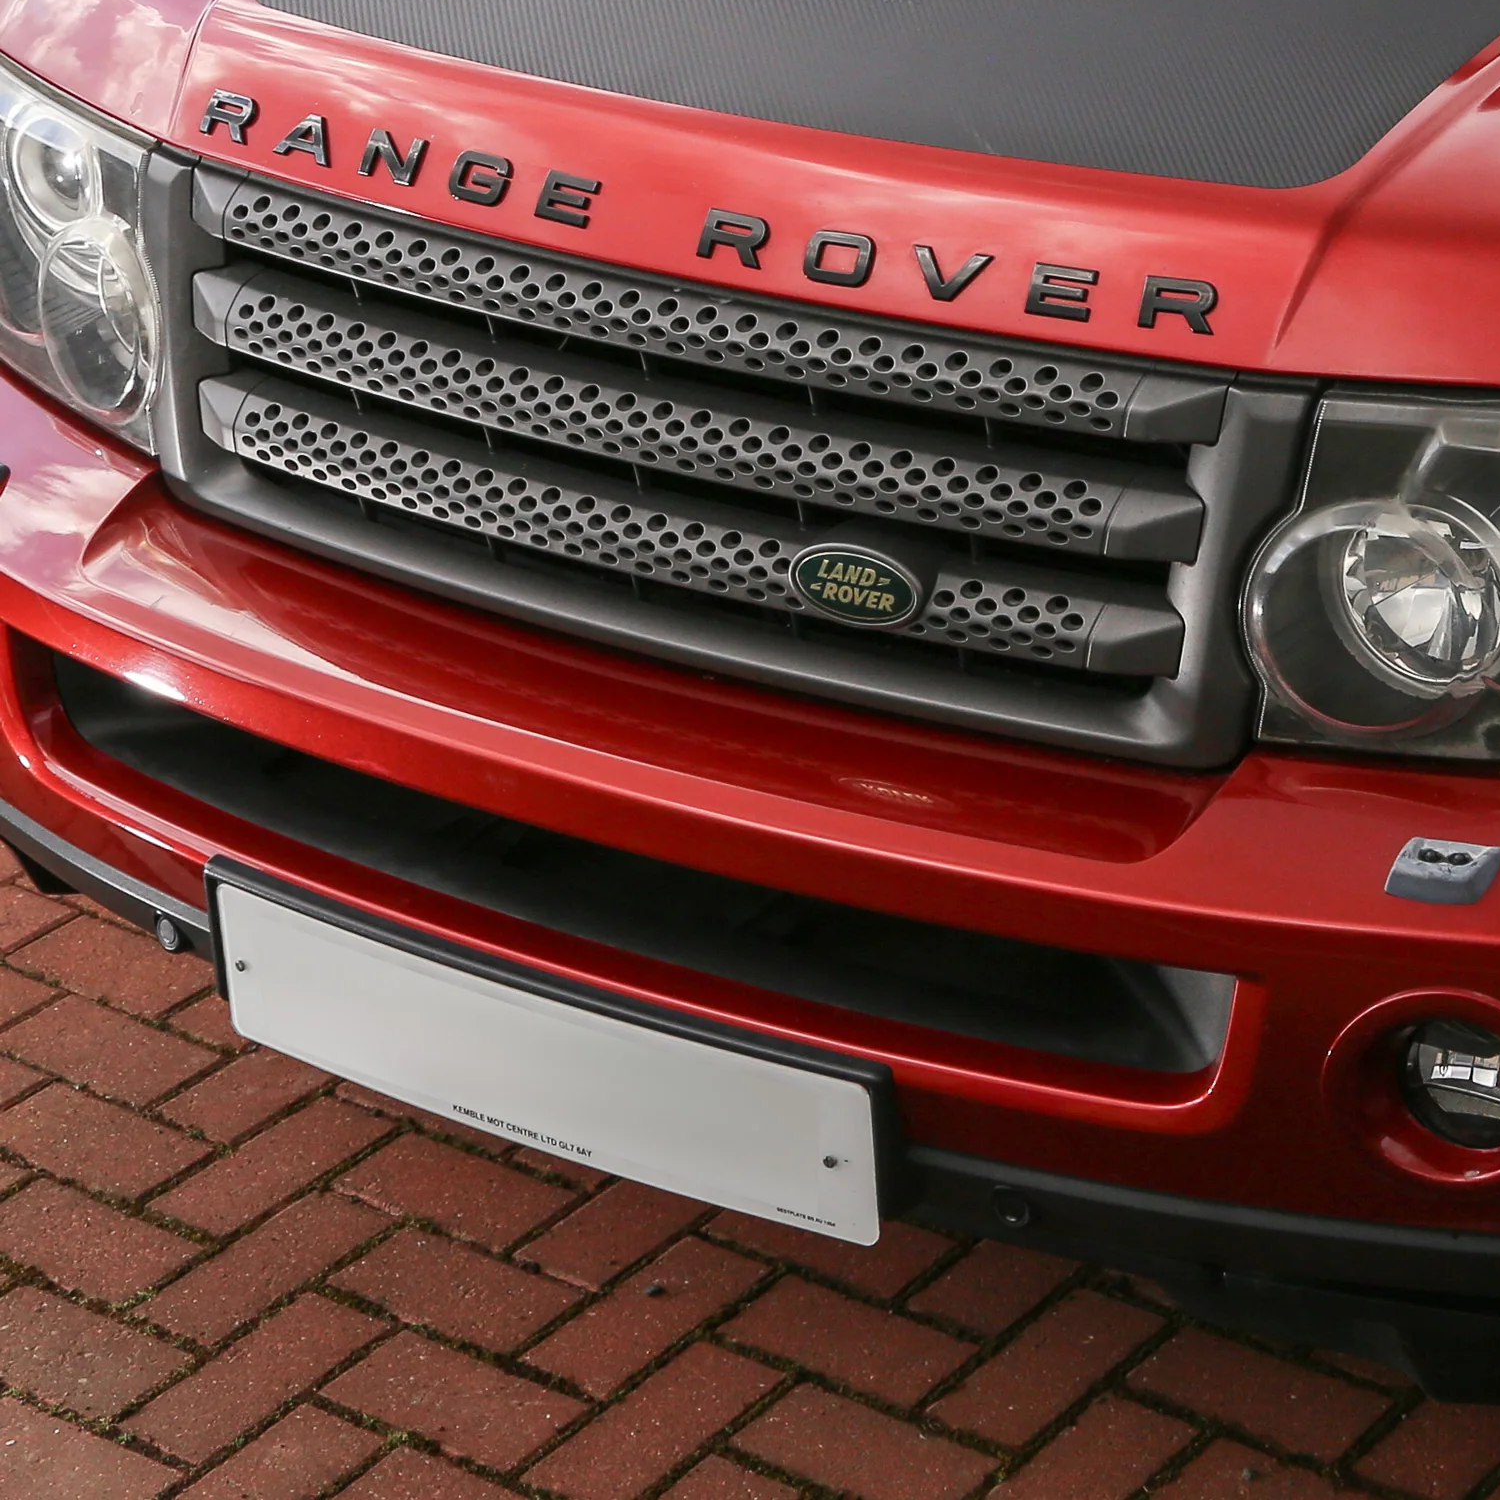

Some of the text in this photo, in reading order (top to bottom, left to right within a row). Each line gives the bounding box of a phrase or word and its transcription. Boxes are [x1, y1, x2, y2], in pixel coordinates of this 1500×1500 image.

[199, 87, 1219, 336] RANGE ROVER
[452, 1103, 593, 1158] KEMBLE MOT CENTRE LTD GL7 6AY
